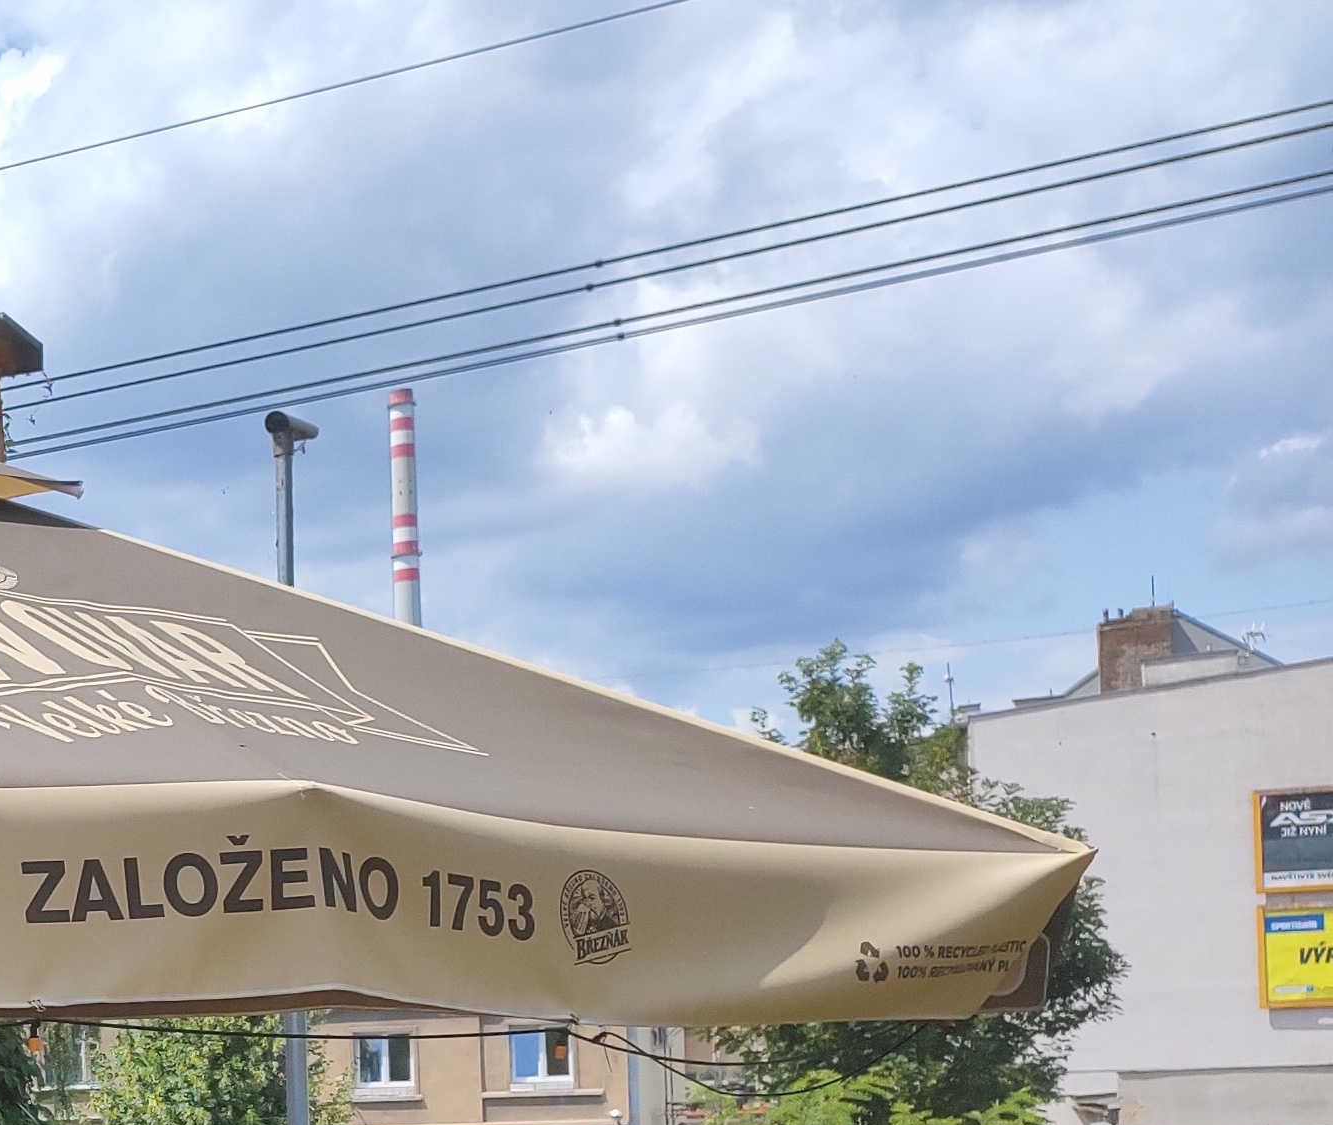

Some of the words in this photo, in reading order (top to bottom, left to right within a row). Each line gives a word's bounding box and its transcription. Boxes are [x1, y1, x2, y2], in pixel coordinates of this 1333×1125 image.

[21, 835, 399, 923] ZALOŽENO
[422, 870, 535, 942] 1753
[896, 945, 921, 958] 100
